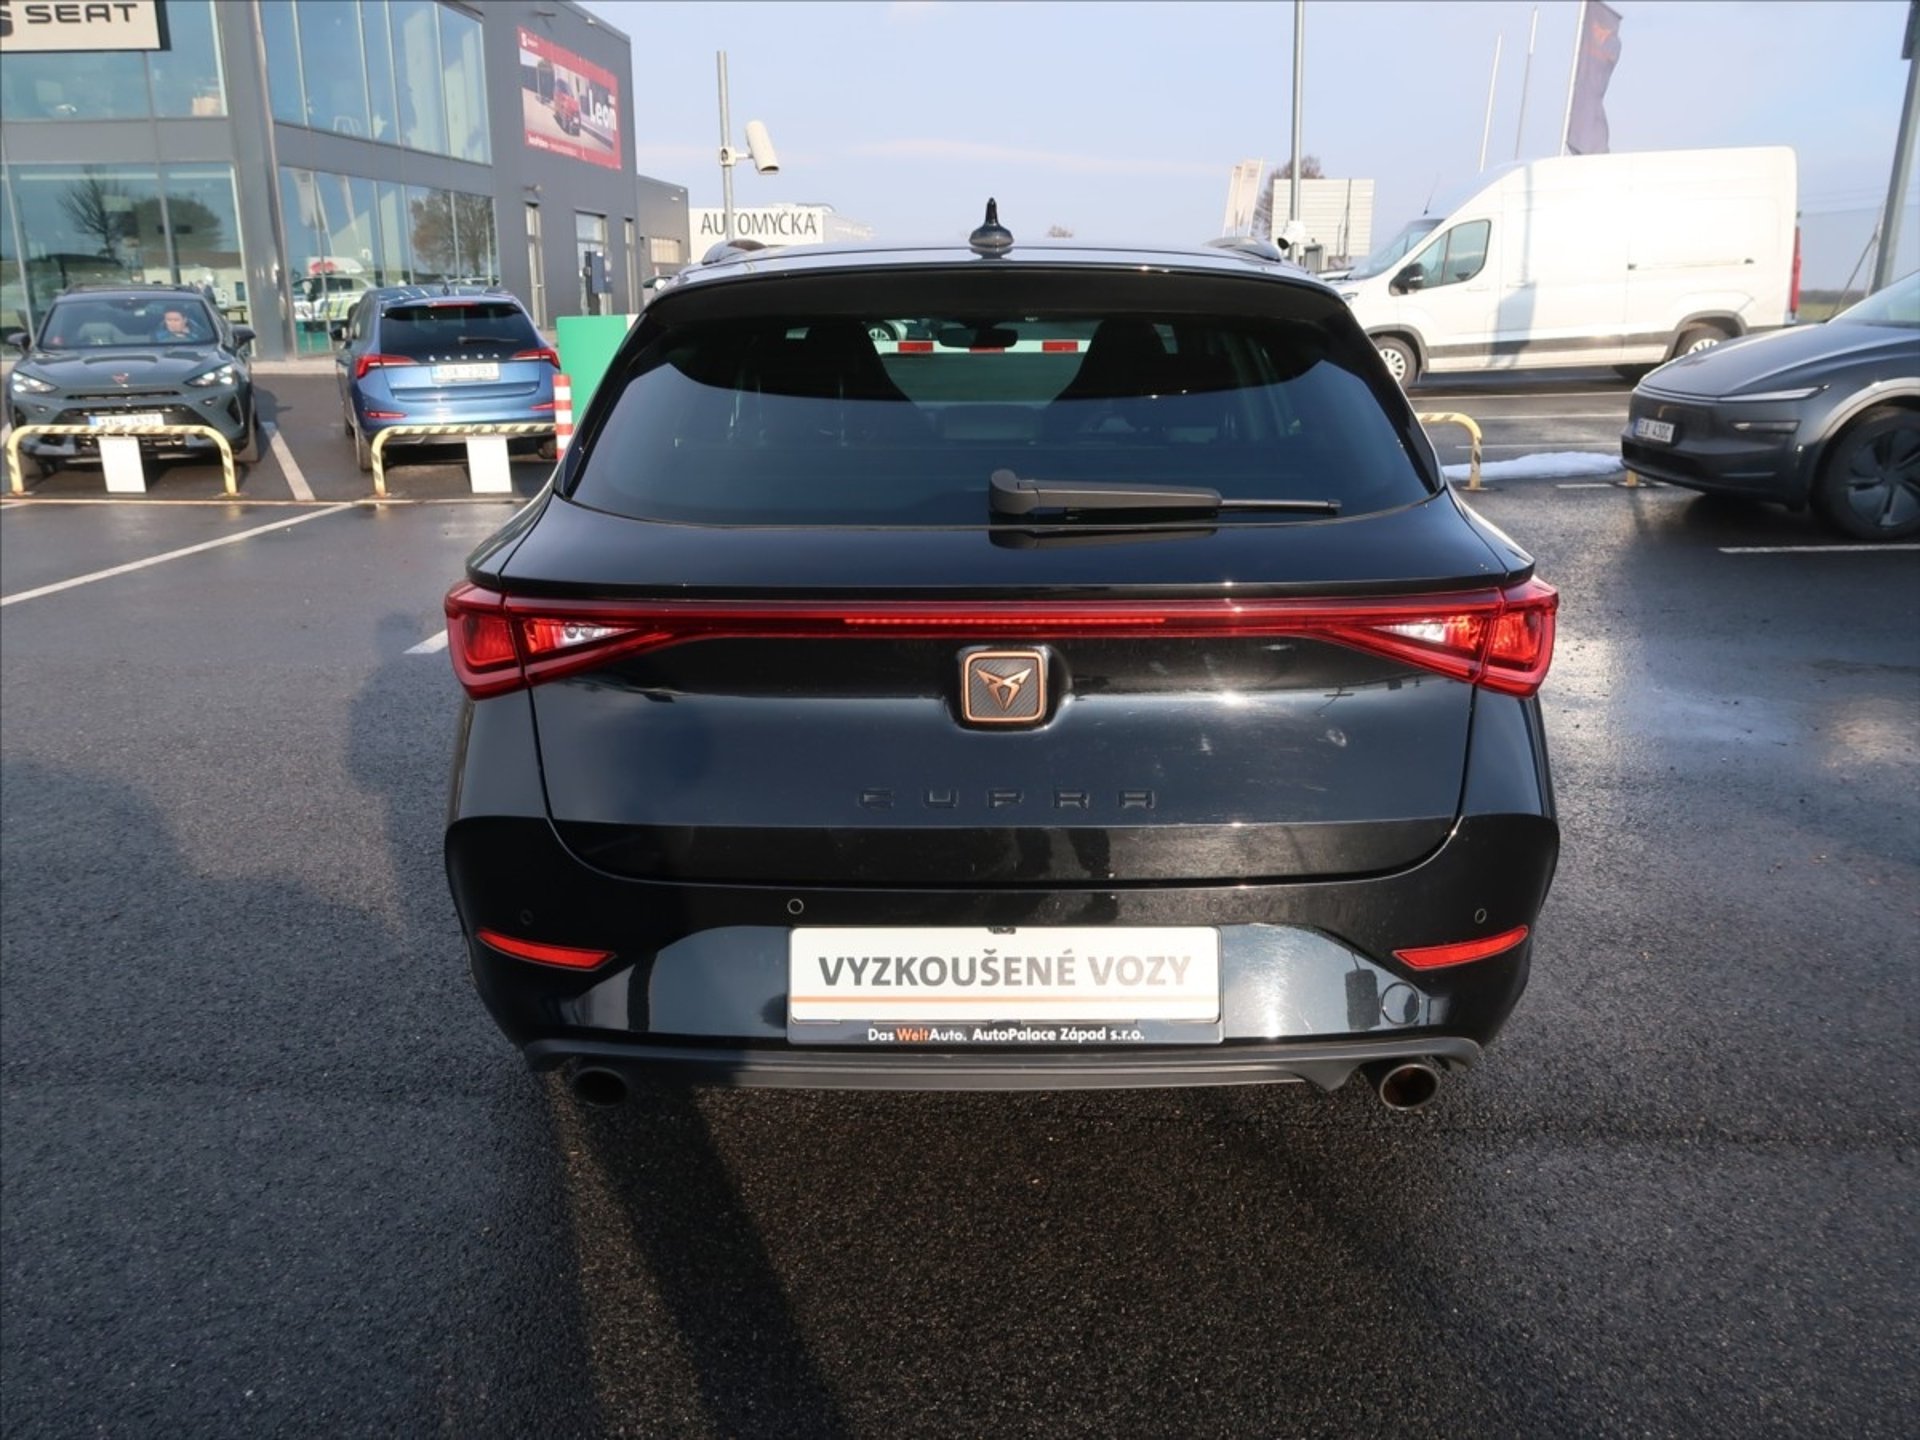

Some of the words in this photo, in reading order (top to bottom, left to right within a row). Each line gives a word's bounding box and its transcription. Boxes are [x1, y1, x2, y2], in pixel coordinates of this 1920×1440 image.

[25, 4, 137, 24] SEAT
[588, 88, 617, 131] Leon
[700, 211, 817, 236] AUOMYČKA
[857, 788, 1156, 810] CUPRA
[818, 948, 1076, 987] VYZKOUŠENÉ
[1088, 956, 1192, 986] VOZY
[868, 1029, 895, 1041] Das
[972, 1028, 1056, 1041] AutoPalace
[1060, 1027, 1106, 1043] Západ
[1110, 1029, 1145, 1041] s.r.o.
